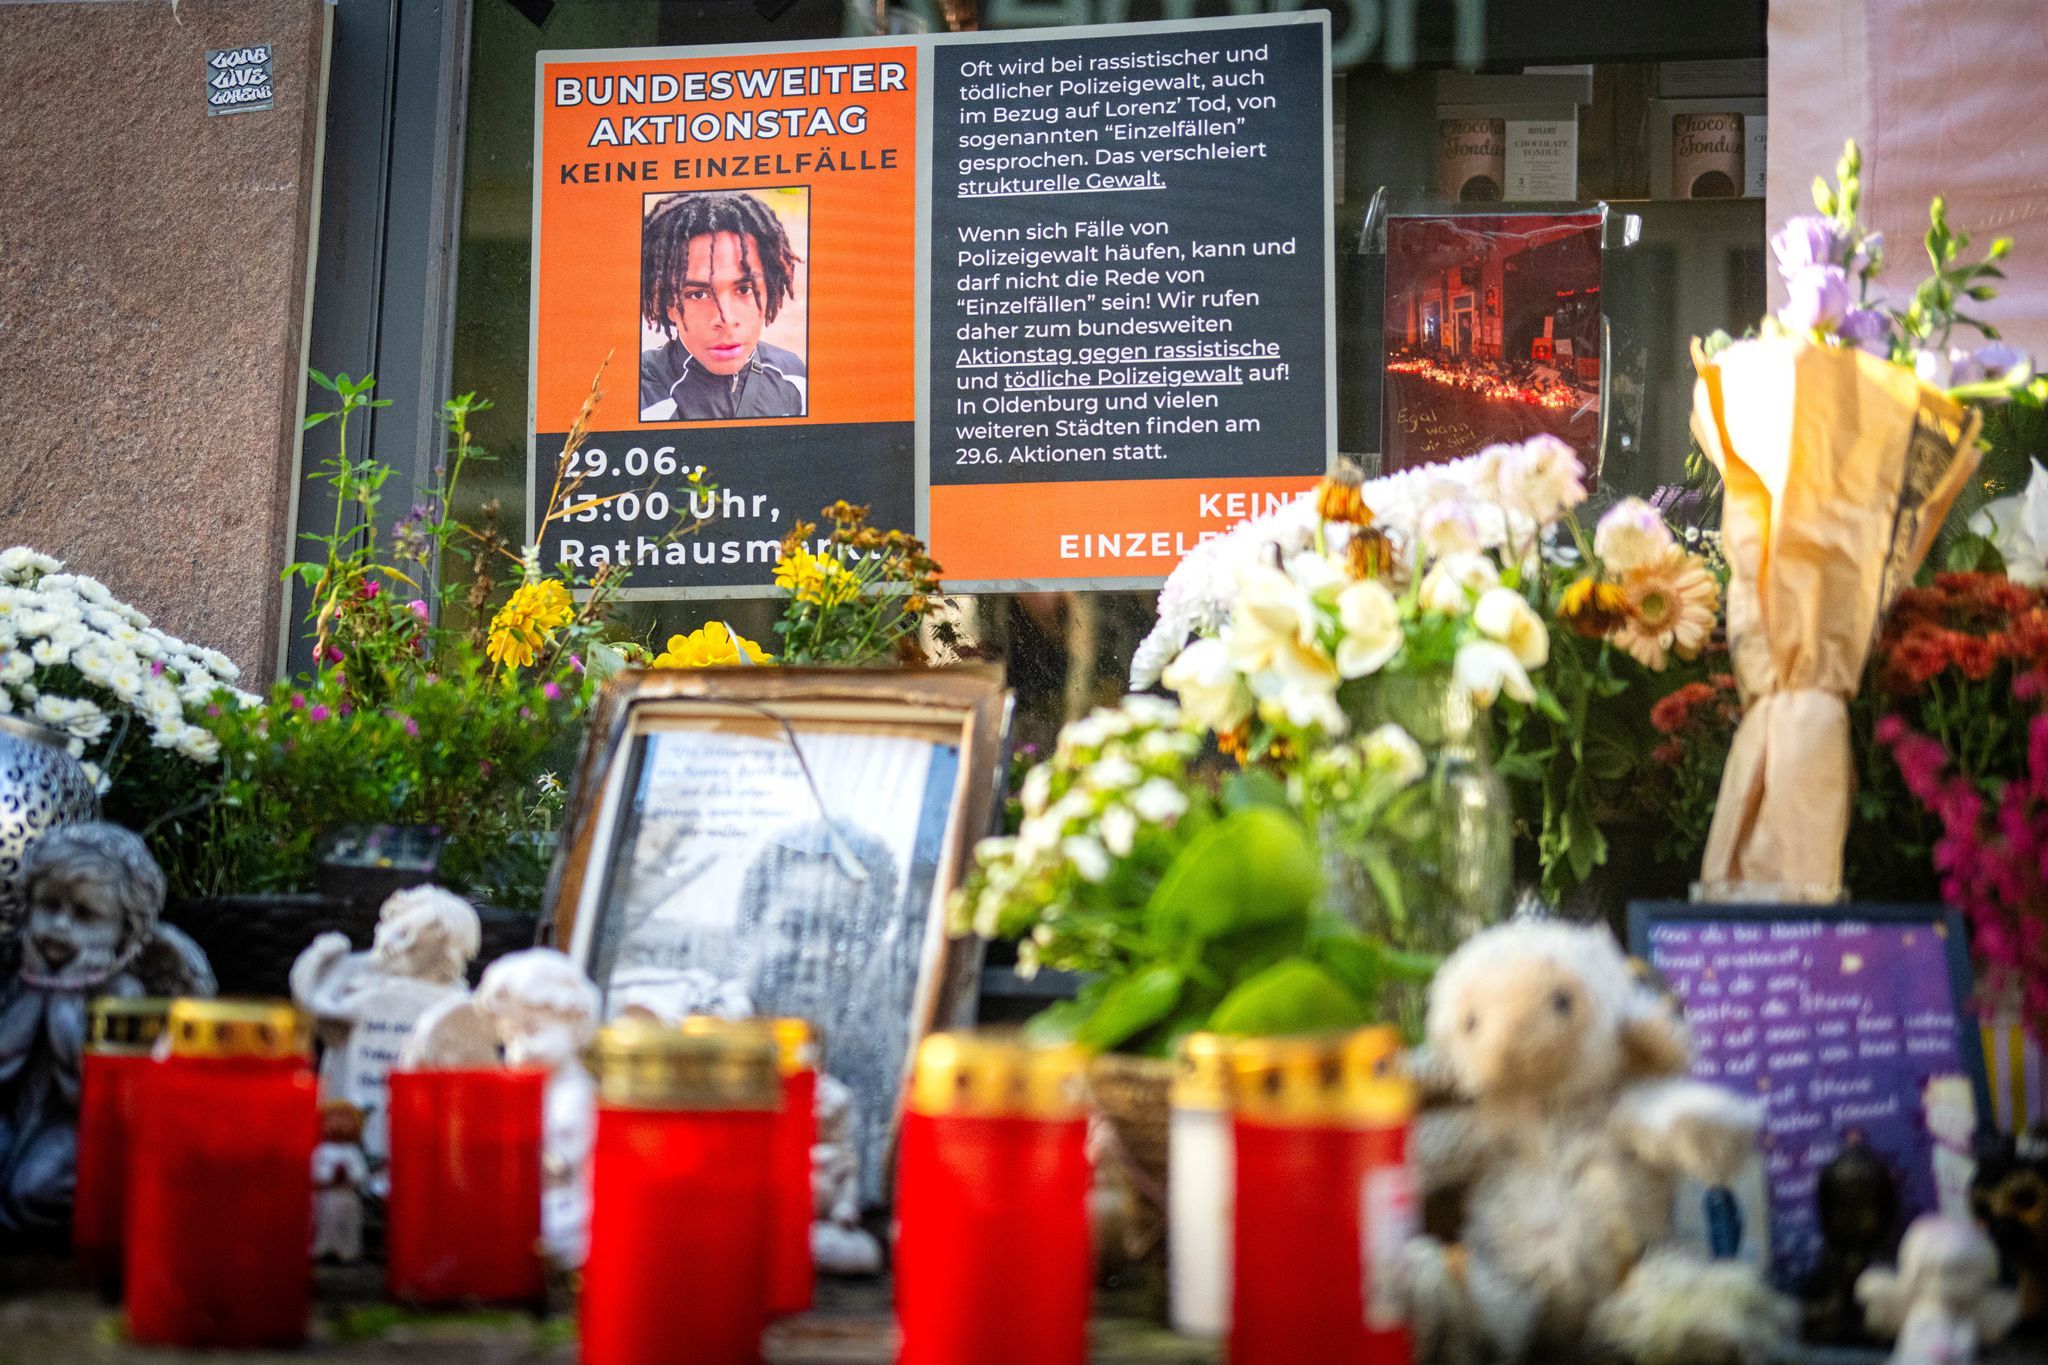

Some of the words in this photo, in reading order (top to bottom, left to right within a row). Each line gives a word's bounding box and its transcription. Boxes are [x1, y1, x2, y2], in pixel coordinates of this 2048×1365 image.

[961, 61, 992, 77] Oft
[999, 58, 1043, 75] wird
[1052, 55, 1082, 72] bei
[1090, 49, 1219, 70] rassistischer
[1227, 44, 1267, 62] und
[209, 66, 270, 90] LIVE
[556, 62, 908, 107] BUNDESWEITER
[960, 82, 1053, 100] tödlicher
[1059, 72, 1206, 99] Polizeigewalt,
[1212, 69, 1264, 87] auch
[961, 108, 985, 123] im
[993, 105, 1058, 127] Bezug
[1066, 102, 1100, 118] auf
[1187, 95, 1230, 113] Tod,
[1237, 96, 1275, 109] von
[587, 105, 868, 148] AKTIONSTAG
[959, 129, 1098, 150] sogenannten
[560, 160, 658, 185] KEINE
[674, 148, 898, 180] EINZELFÄLLE
[959, 151, 1088, 175] gesprochen.
[1096, 149, 1134, 164] Das
[1140, 142, 1266, 162] verschleiert
[957, 174, 1080, 199] strukturelle
[1086, 169, 1166, 193] Gewalt.
[958, 227, 1019, 242] Wenn
[1027, 222, 1067, 240] sich
[1076, 220, 1124, 237] Fälle
[1130, 222, 1168, 235] von
[959, 246, 1098, 268] Polizeigewalt
[1106, 243, 1185, 261] häufen,
[1193, 241, 1245, 257] kann
[1254, 237, 1295, 255] und
[957, 273, 1000, 291] darf
[1006, 272, 1059, 289] nicht
[1066, 270, 1098, 287] die
[1106, 268, 1159, 285] Rede
[1166, 270, 1204, 283] von
[1102, 293, 1150, 310] sein!
[1158, 291, 1195, 308] Wir
[1203, 289, 1259, 307] rufen
[957, 323, 1018, 340] daher
[1025, 324, 1070, 338] zum
[1079, 315, 1232, 336] bundesweiten
[956, 347, 1071, 368] Aktionstag
[1079, 345, 1148, 365] gegen
[1154, 339, 1280, 361] rassistische
[957, 372, 997, 389] und
[1004, 369, 1091, 392] tödliche
[1097, 366, 1243, 389] Polizeigewalt
[1249, 363, 1289, 381] auf!
[958, 399, 975, 414] In
[983, 395, 1097, 414] Oldenburg
[1106, 392, 1147, 410] und
[1154, 391, 1218, 408] vielen
[956, 422, 1048, 439] weiteren
[1056, 418, 1139, 436] Städten
[1146, 416, 1218, 434] finden
[1225, 415, 1260, 432] am
[1396, 408, 1438, 433] Egal
[956, 448, 1002, 464] 29.6.
[1008, 445, 1105, 463] Aktionen
[1113, 444, 1167, 460] statt.
[689, 488, 780, 523] Uhr,
